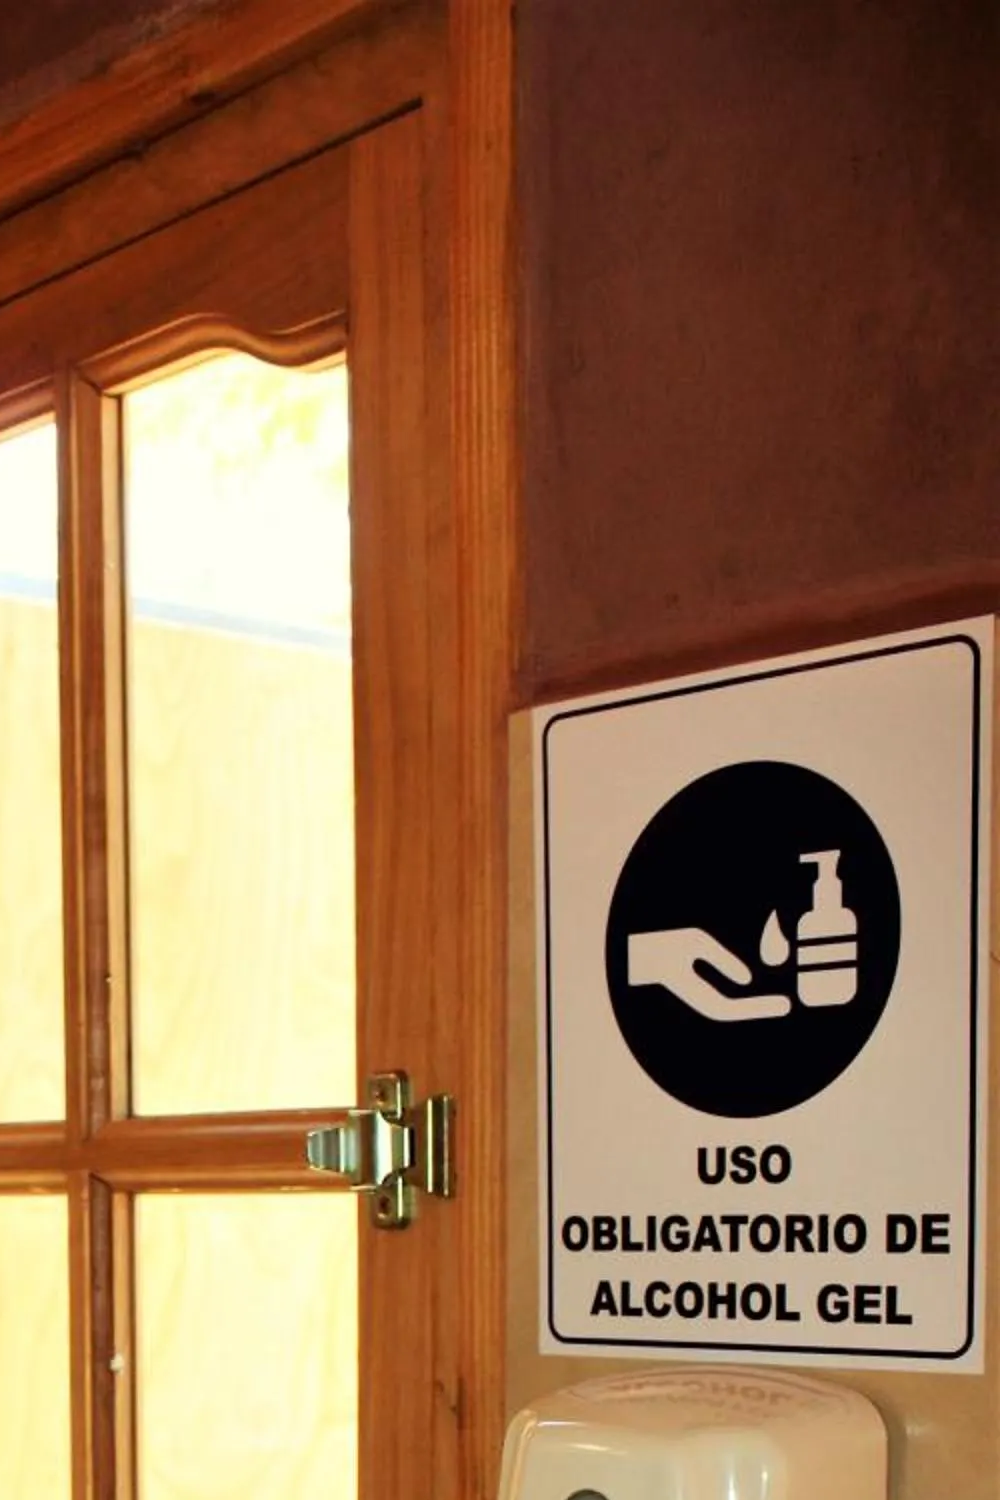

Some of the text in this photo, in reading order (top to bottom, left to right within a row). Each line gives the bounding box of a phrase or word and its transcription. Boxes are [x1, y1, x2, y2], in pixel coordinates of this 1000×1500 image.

[698, 1145, 791, 1184] USO
[562, 1214, 950, 1253] OBLIGATORIO DE
[590, 1281, 912, 1324] ALCOHOL GEL
